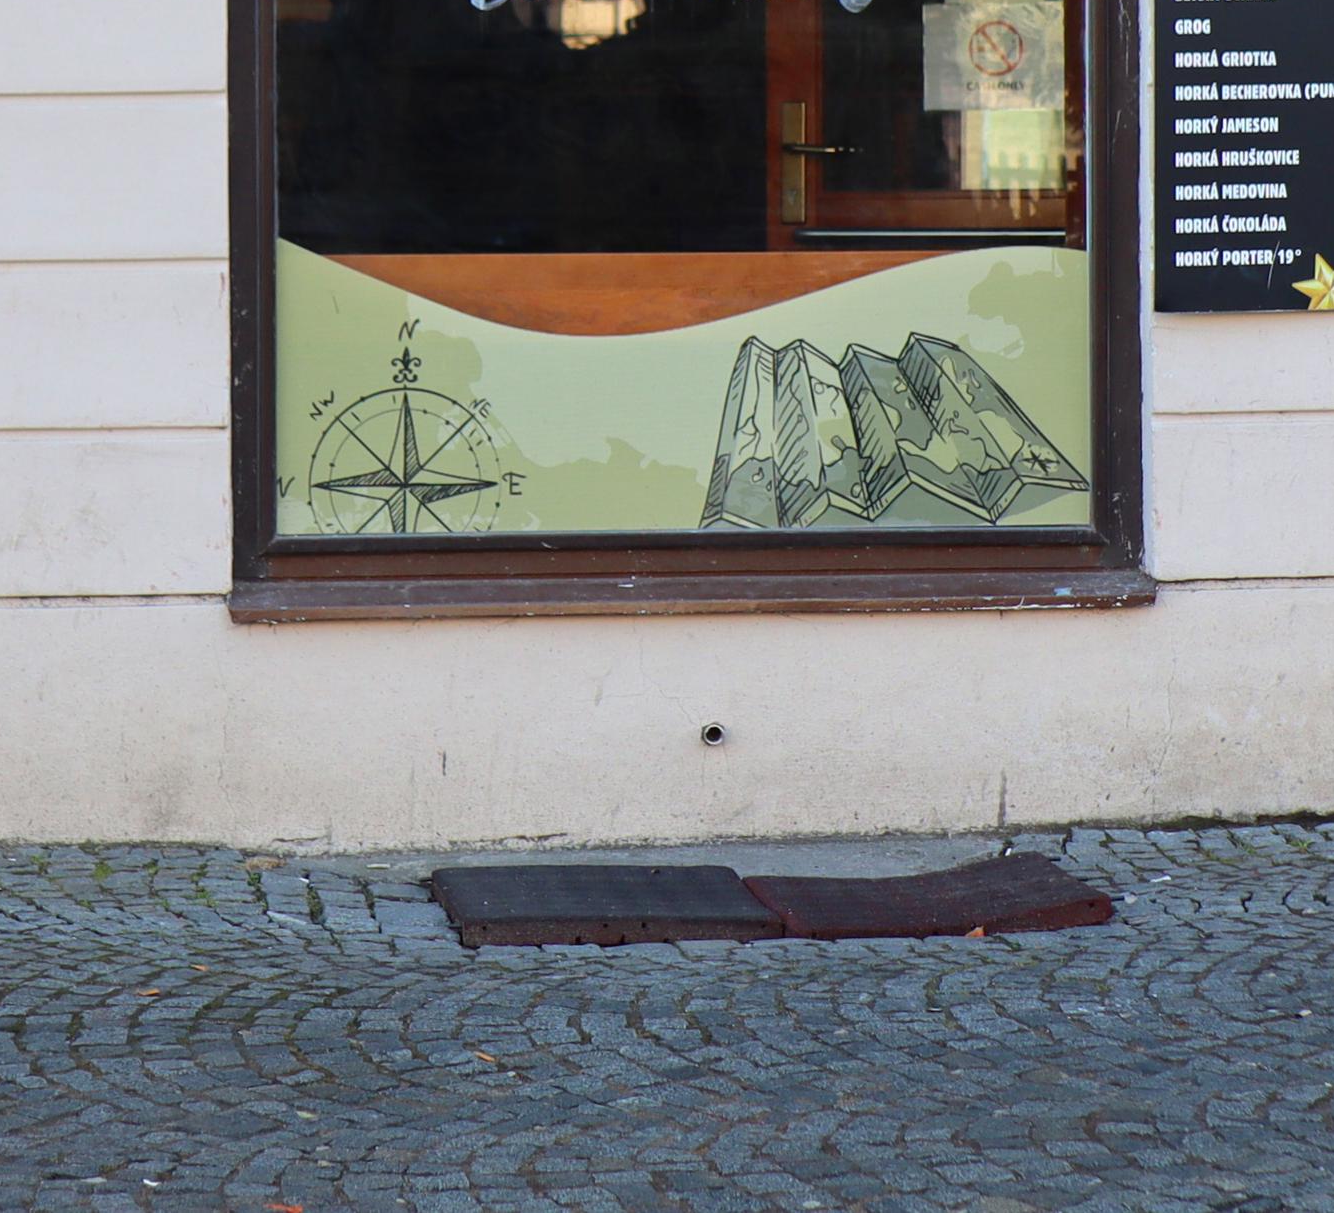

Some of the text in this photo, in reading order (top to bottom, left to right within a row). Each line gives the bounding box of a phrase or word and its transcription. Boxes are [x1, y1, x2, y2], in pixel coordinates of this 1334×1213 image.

[1175, 18, 1211, 34] GROG
[1175, 49, 1218, 67] HORKÁ
[1222, 51, 1277, 67] GRIOTKA
[1175, 83, 1218, 101] HORKÁ
[1222, 84, 1301, 100] BECHEROVKA
[1175, 116, 1218, 134] HORKÝ
[1222, 117, 1279, 133] JAMESON
[1175, 148, 1218, 167] HORKÁ
[1222, 148, 1300, 166] HRUŠKOVICE
[1175, 182, 1219, 200] HORKÁ
[1222, 183, 1287, 199] MEDOVINA
[1176, 215, 1219, 233] HORKÁ
[1222, 214, 1287, 232] ČOKOLÁDA
[1176, 248, 1219, 266] HORKÝ
[1223, 249, 1273, 265] PORTER
[1276, 248, 1302, 265] 19°
[398, 319, 419, 341] N
[310, 390, 334, 421] NW
[469, 398, 491, 418] NE
[502, 472, 526, 495] E
